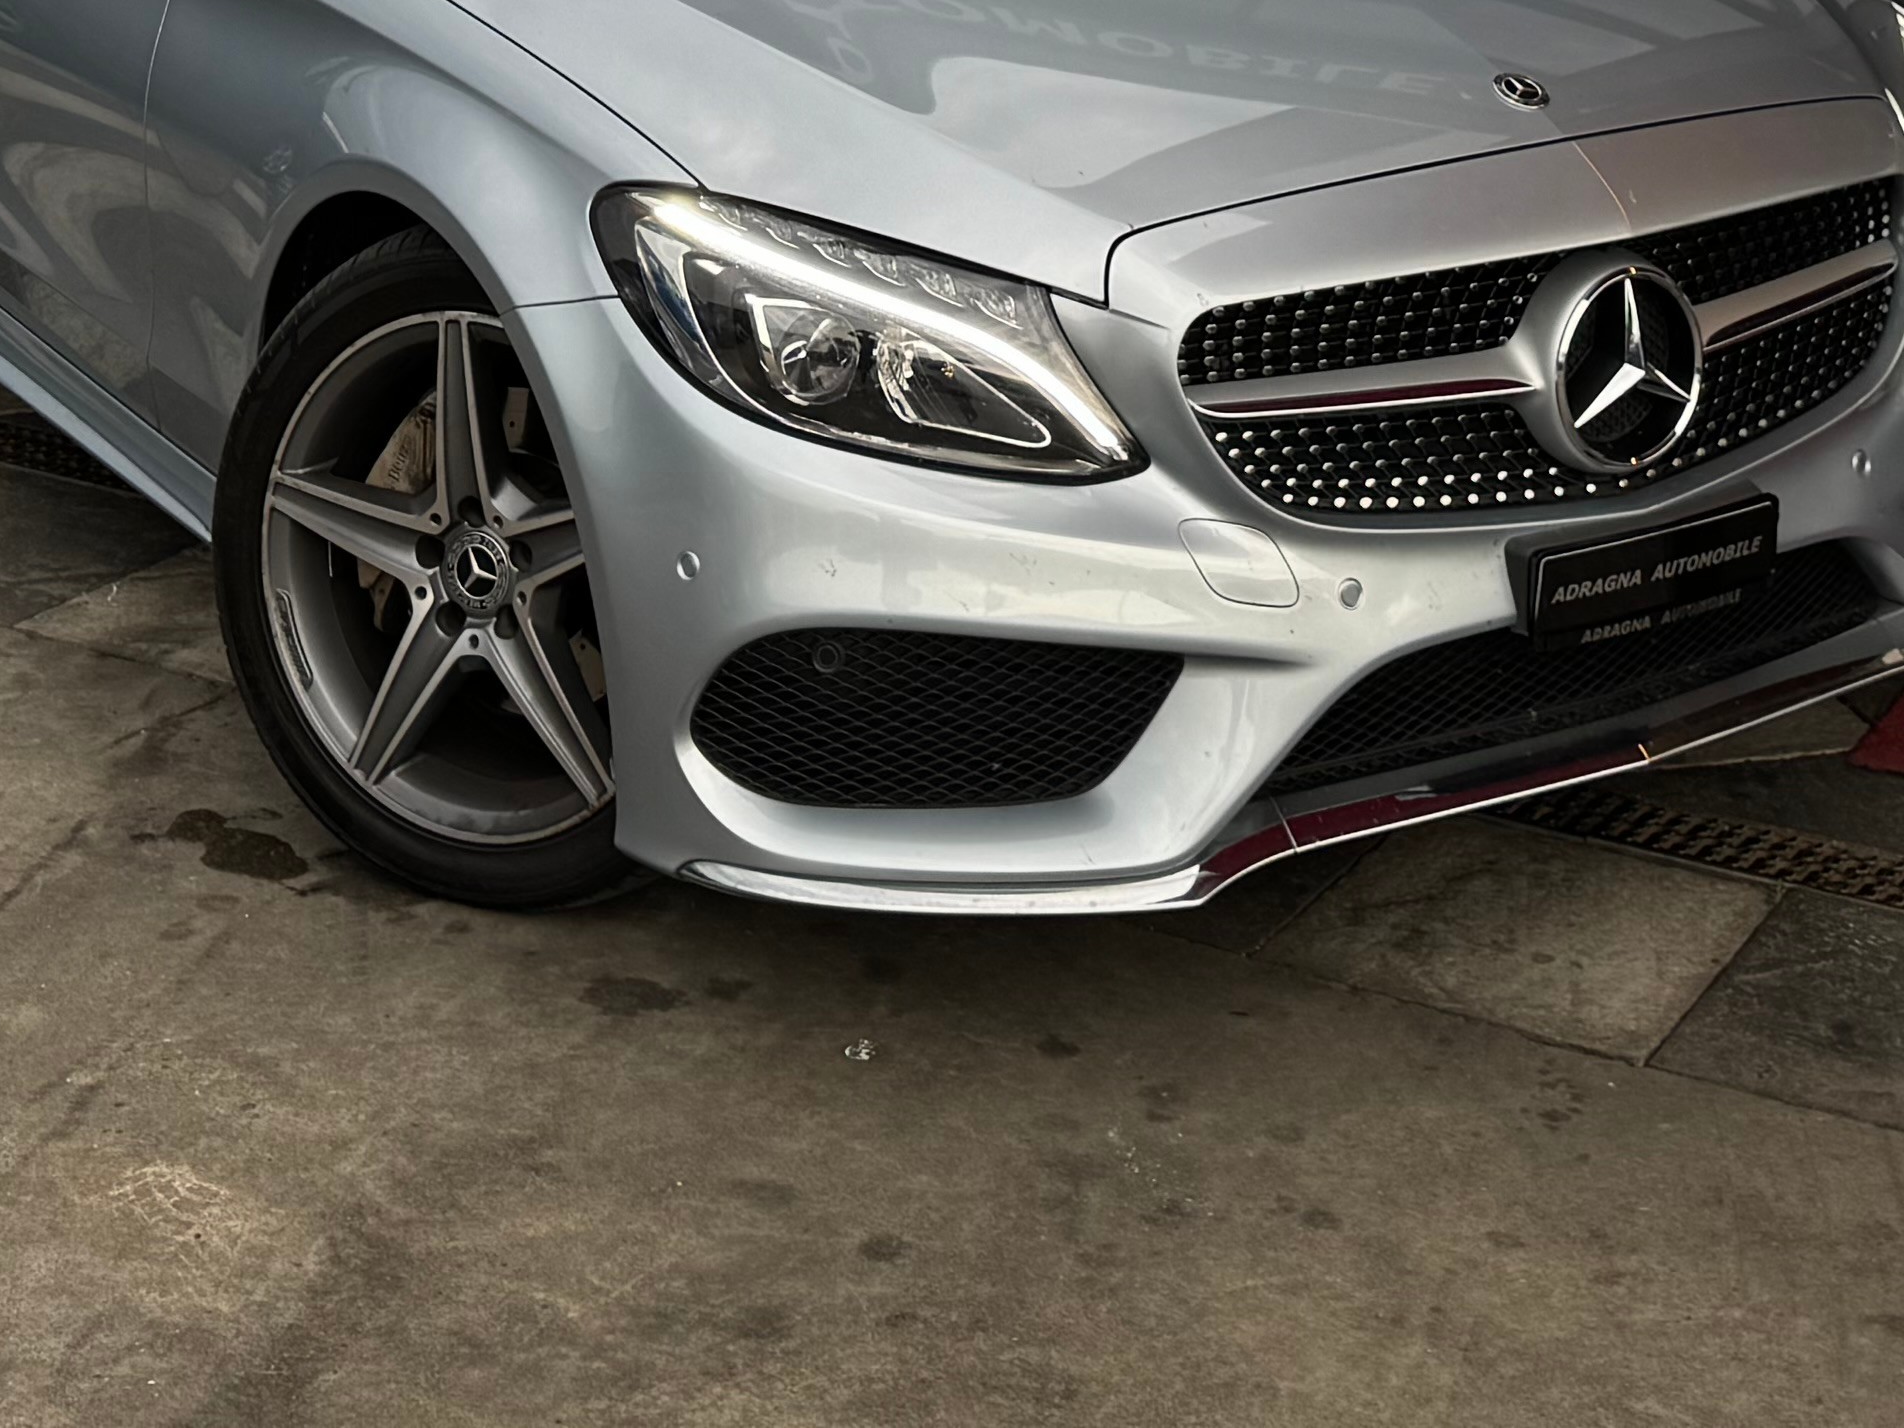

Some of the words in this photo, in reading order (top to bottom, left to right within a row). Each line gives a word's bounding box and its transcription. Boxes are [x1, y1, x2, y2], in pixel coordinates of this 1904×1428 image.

[1551, 569, 1642, 604] ADRAGNA
[1650, 535, 1763, 582] AUTOMOBILE
[1580, 615, 1652, 643] ADRAGNA
